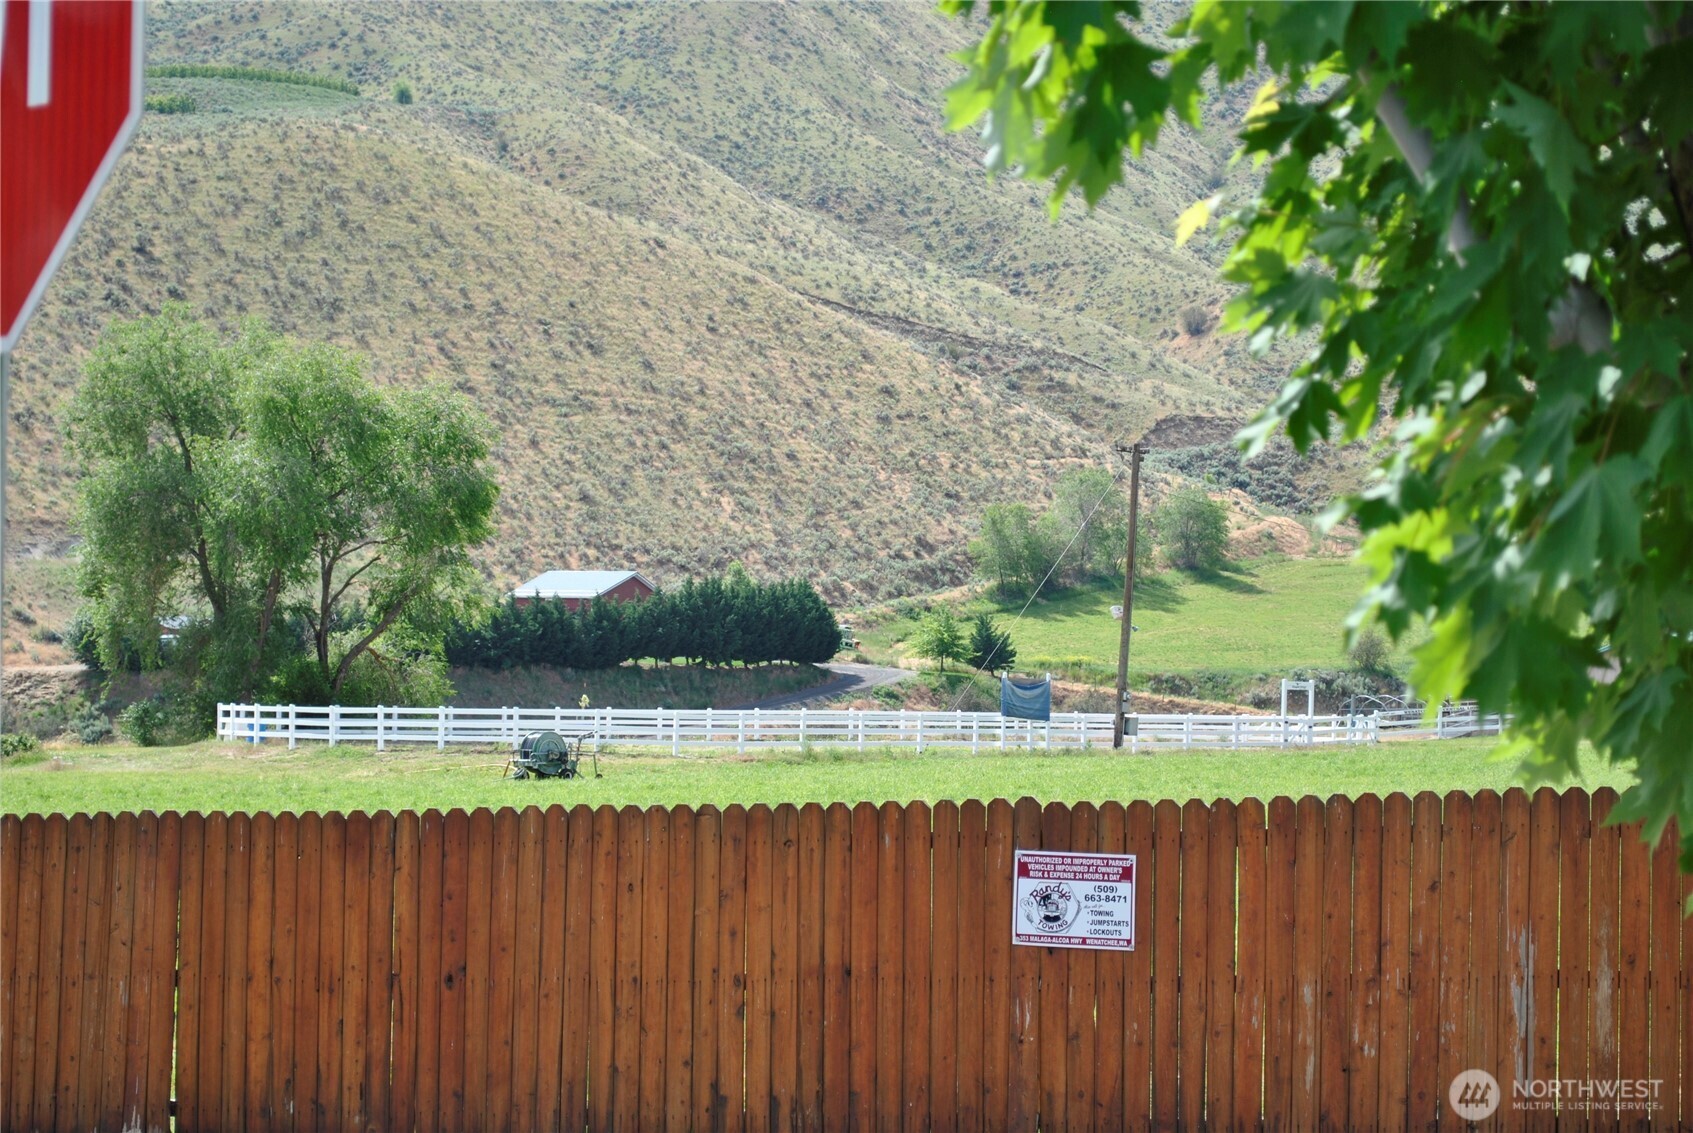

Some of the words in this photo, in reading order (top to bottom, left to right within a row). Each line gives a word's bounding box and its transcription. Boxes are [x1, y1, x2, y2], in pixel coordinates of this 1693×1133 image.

[1020, 856, 1062, 864] UNAUTHORIZED
[1073, 858, 1108, 866] IMPROPERLY
[1109, 859, 1131, 867] PARKED
[1028, 863, 1055, 871] VEHICLES
[1097, 866, 1123, 874] OWNER'S
[1029, 870, 1043, 878] RISK
[1049, 871, 1075, 879] EXPENSE
[1029, 881, 1071, 904] Randy's
[1093, 885, 1118, 894] (509)
[1084, 894, 1127, 903] 663-8471
[1037, 919, 1068, 930] TOWING
